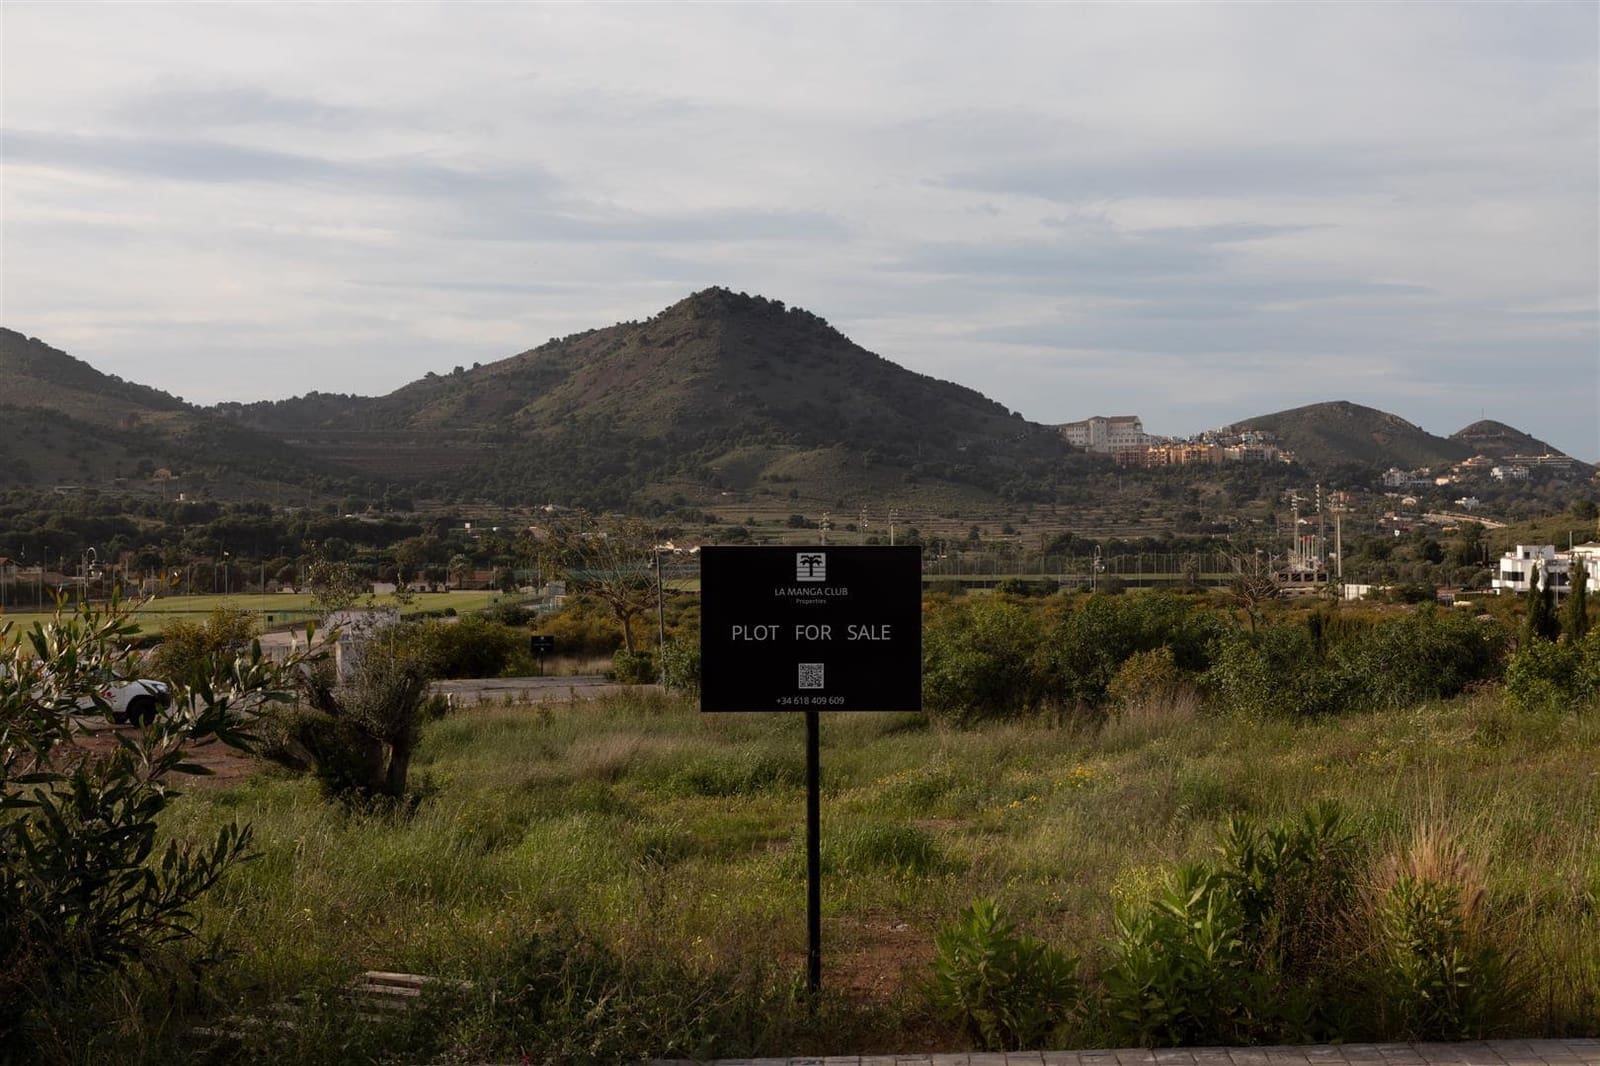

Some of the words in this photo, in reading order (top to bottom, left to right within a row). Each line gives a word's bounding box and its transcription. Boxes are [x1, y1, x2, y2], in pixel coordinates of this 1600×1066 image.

[774, 587, 786, 596] LA
[787, 587, 824, 596] MANGA
[824, 587, 849, 596] CLUB
[732, 624, 781, 641] PLOT
[795, 624, 832, 641] FOR
[847, 624, 892, 641] SALE
[776, 696, 793, 705] +34
[793, 696, 810, 705] 618
[811, 696, 828, 705] 409
[828, 696, 845, 705] 609
